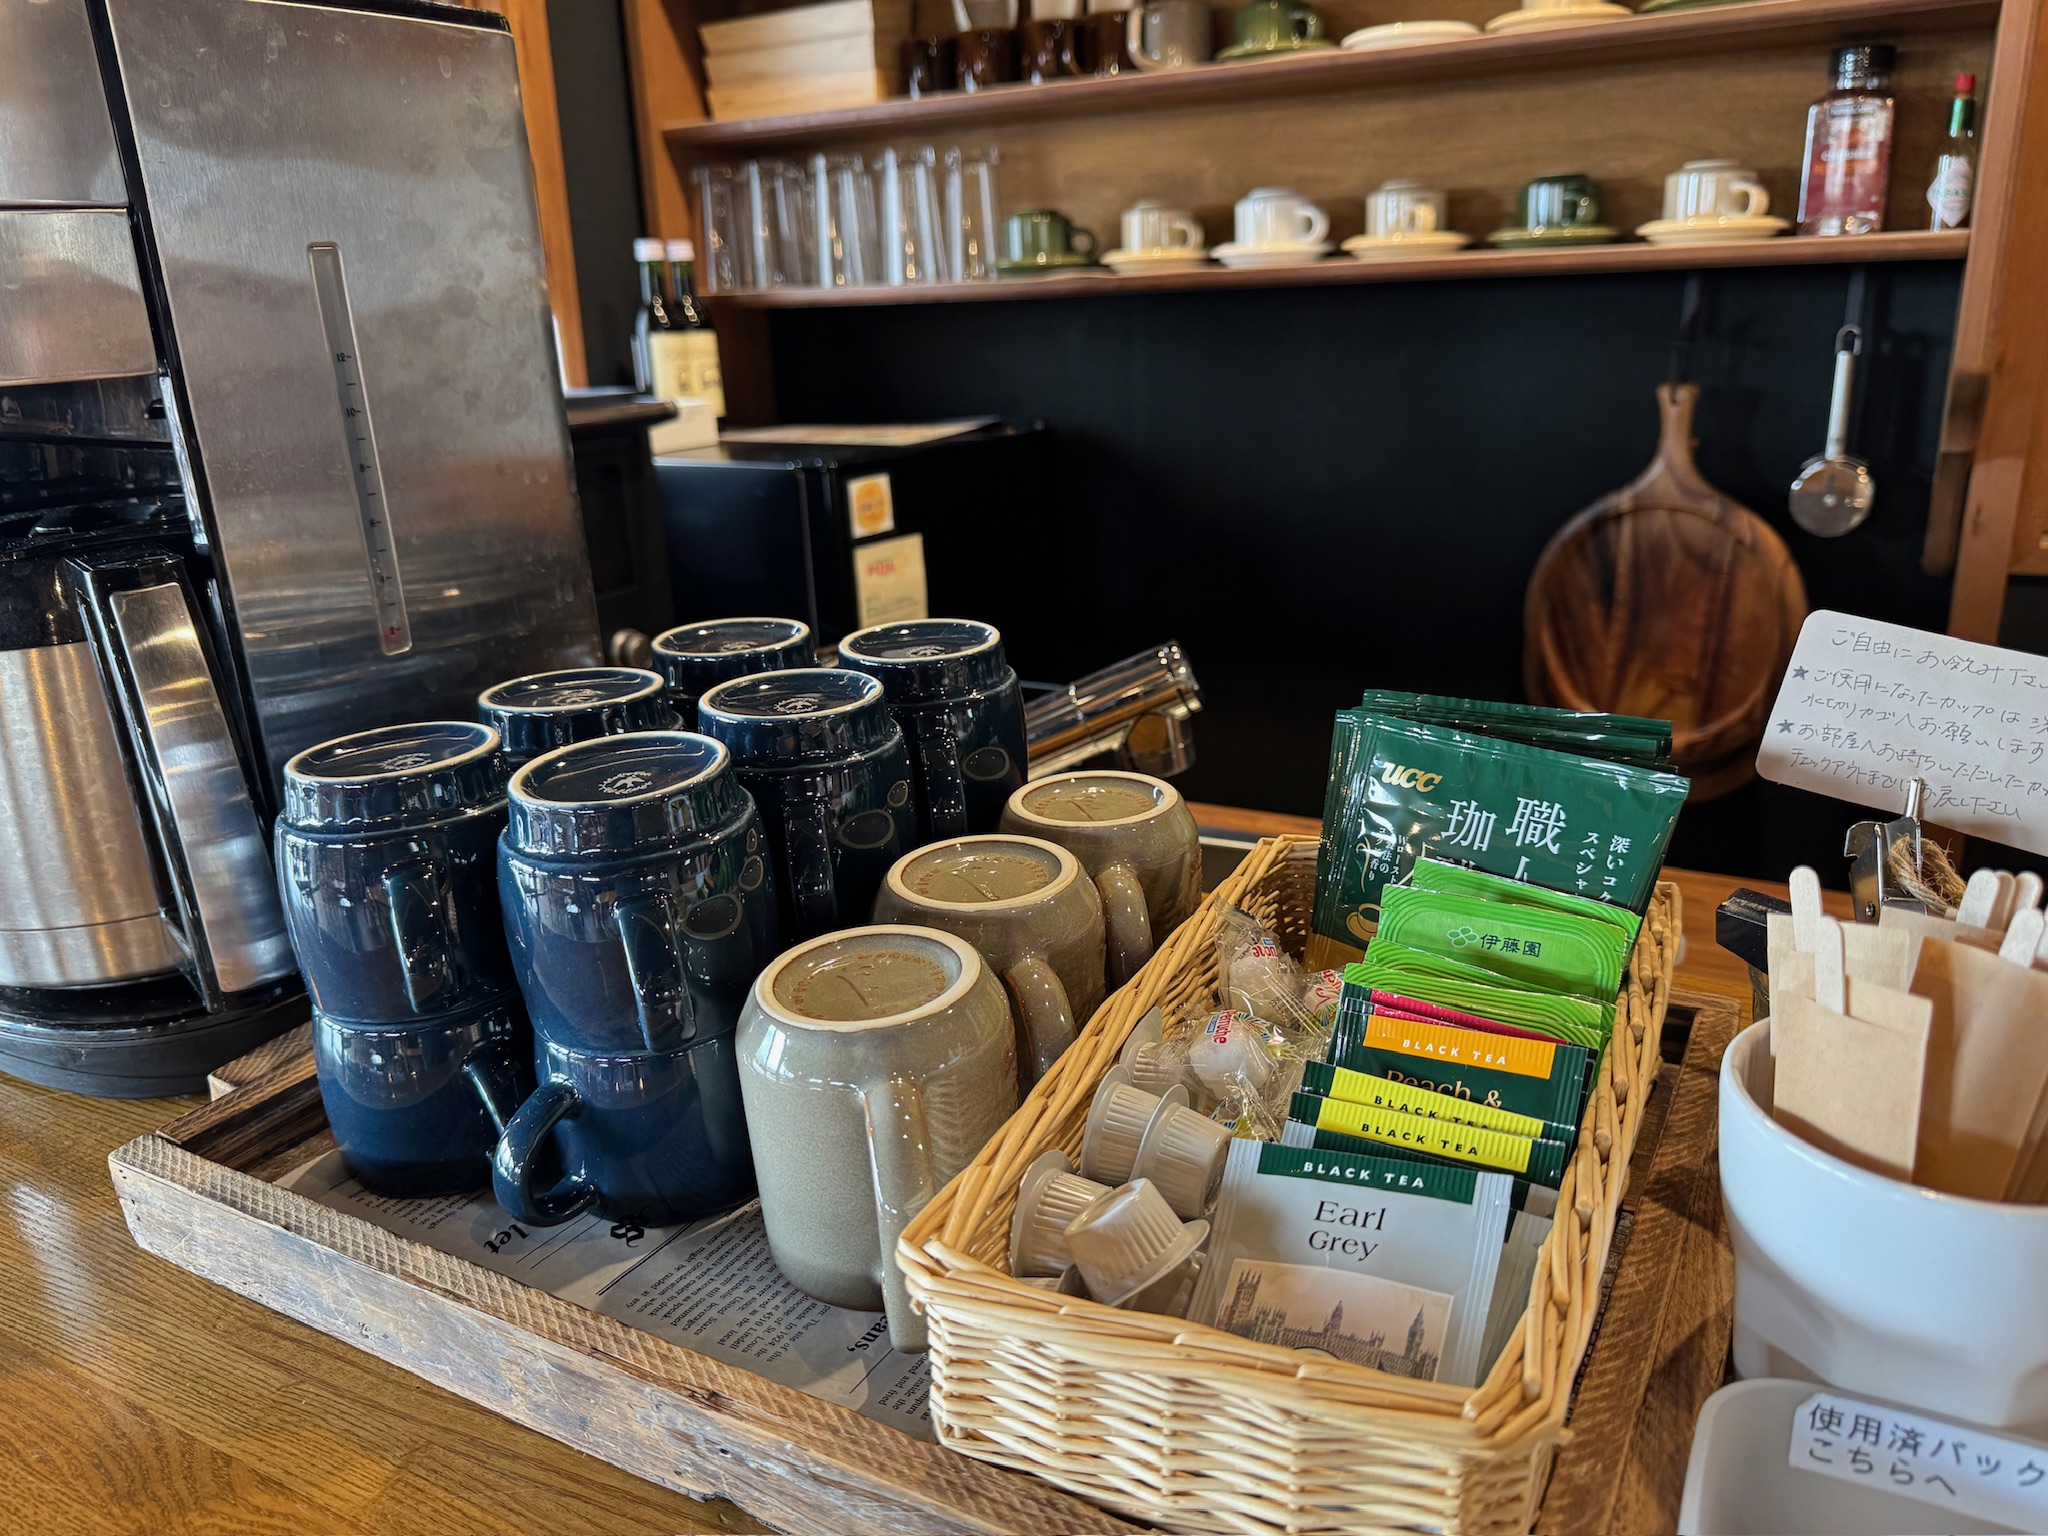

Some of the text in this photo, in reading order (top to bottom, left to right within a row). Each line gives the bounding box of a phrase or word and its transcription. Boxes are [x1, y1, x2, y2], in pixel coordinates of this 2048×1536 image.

[336, 352, 346, 362] 12
[346, 407, 356, 418] 10
[1575, 831, 1599, 894] スペシャ
[1480, 932, 1542, 958] 伊藤園
[1402, 1039, 1507, 1065] BLACK TEA
[1374, 1095, 1439, 1119] BLACK
[1483, 1090, 1503, 1108] &
[1361, 1123, 1478, 1156] BLACK TEA
[1303, 1161, 1425, 1188] BLACK TEA
[1314, 1200, 1386, 1231] Earl
[737, 1247, 765, 1271] cocktails
[1308, 1230, 1379, 1261] Grey
[657, 1261, 703, 1296] consideration
[719, 1274, 751, 1299] alcoholic
[670, 1297, 705, 1326] consumed
[682, 1302, 718, 1331] beverages
[741, 1336, 764, 1353] Louis
[1809, 1403, 2045, 1487] 使用済パック
[1809, 1437, 1956, 1495] こちらへ
